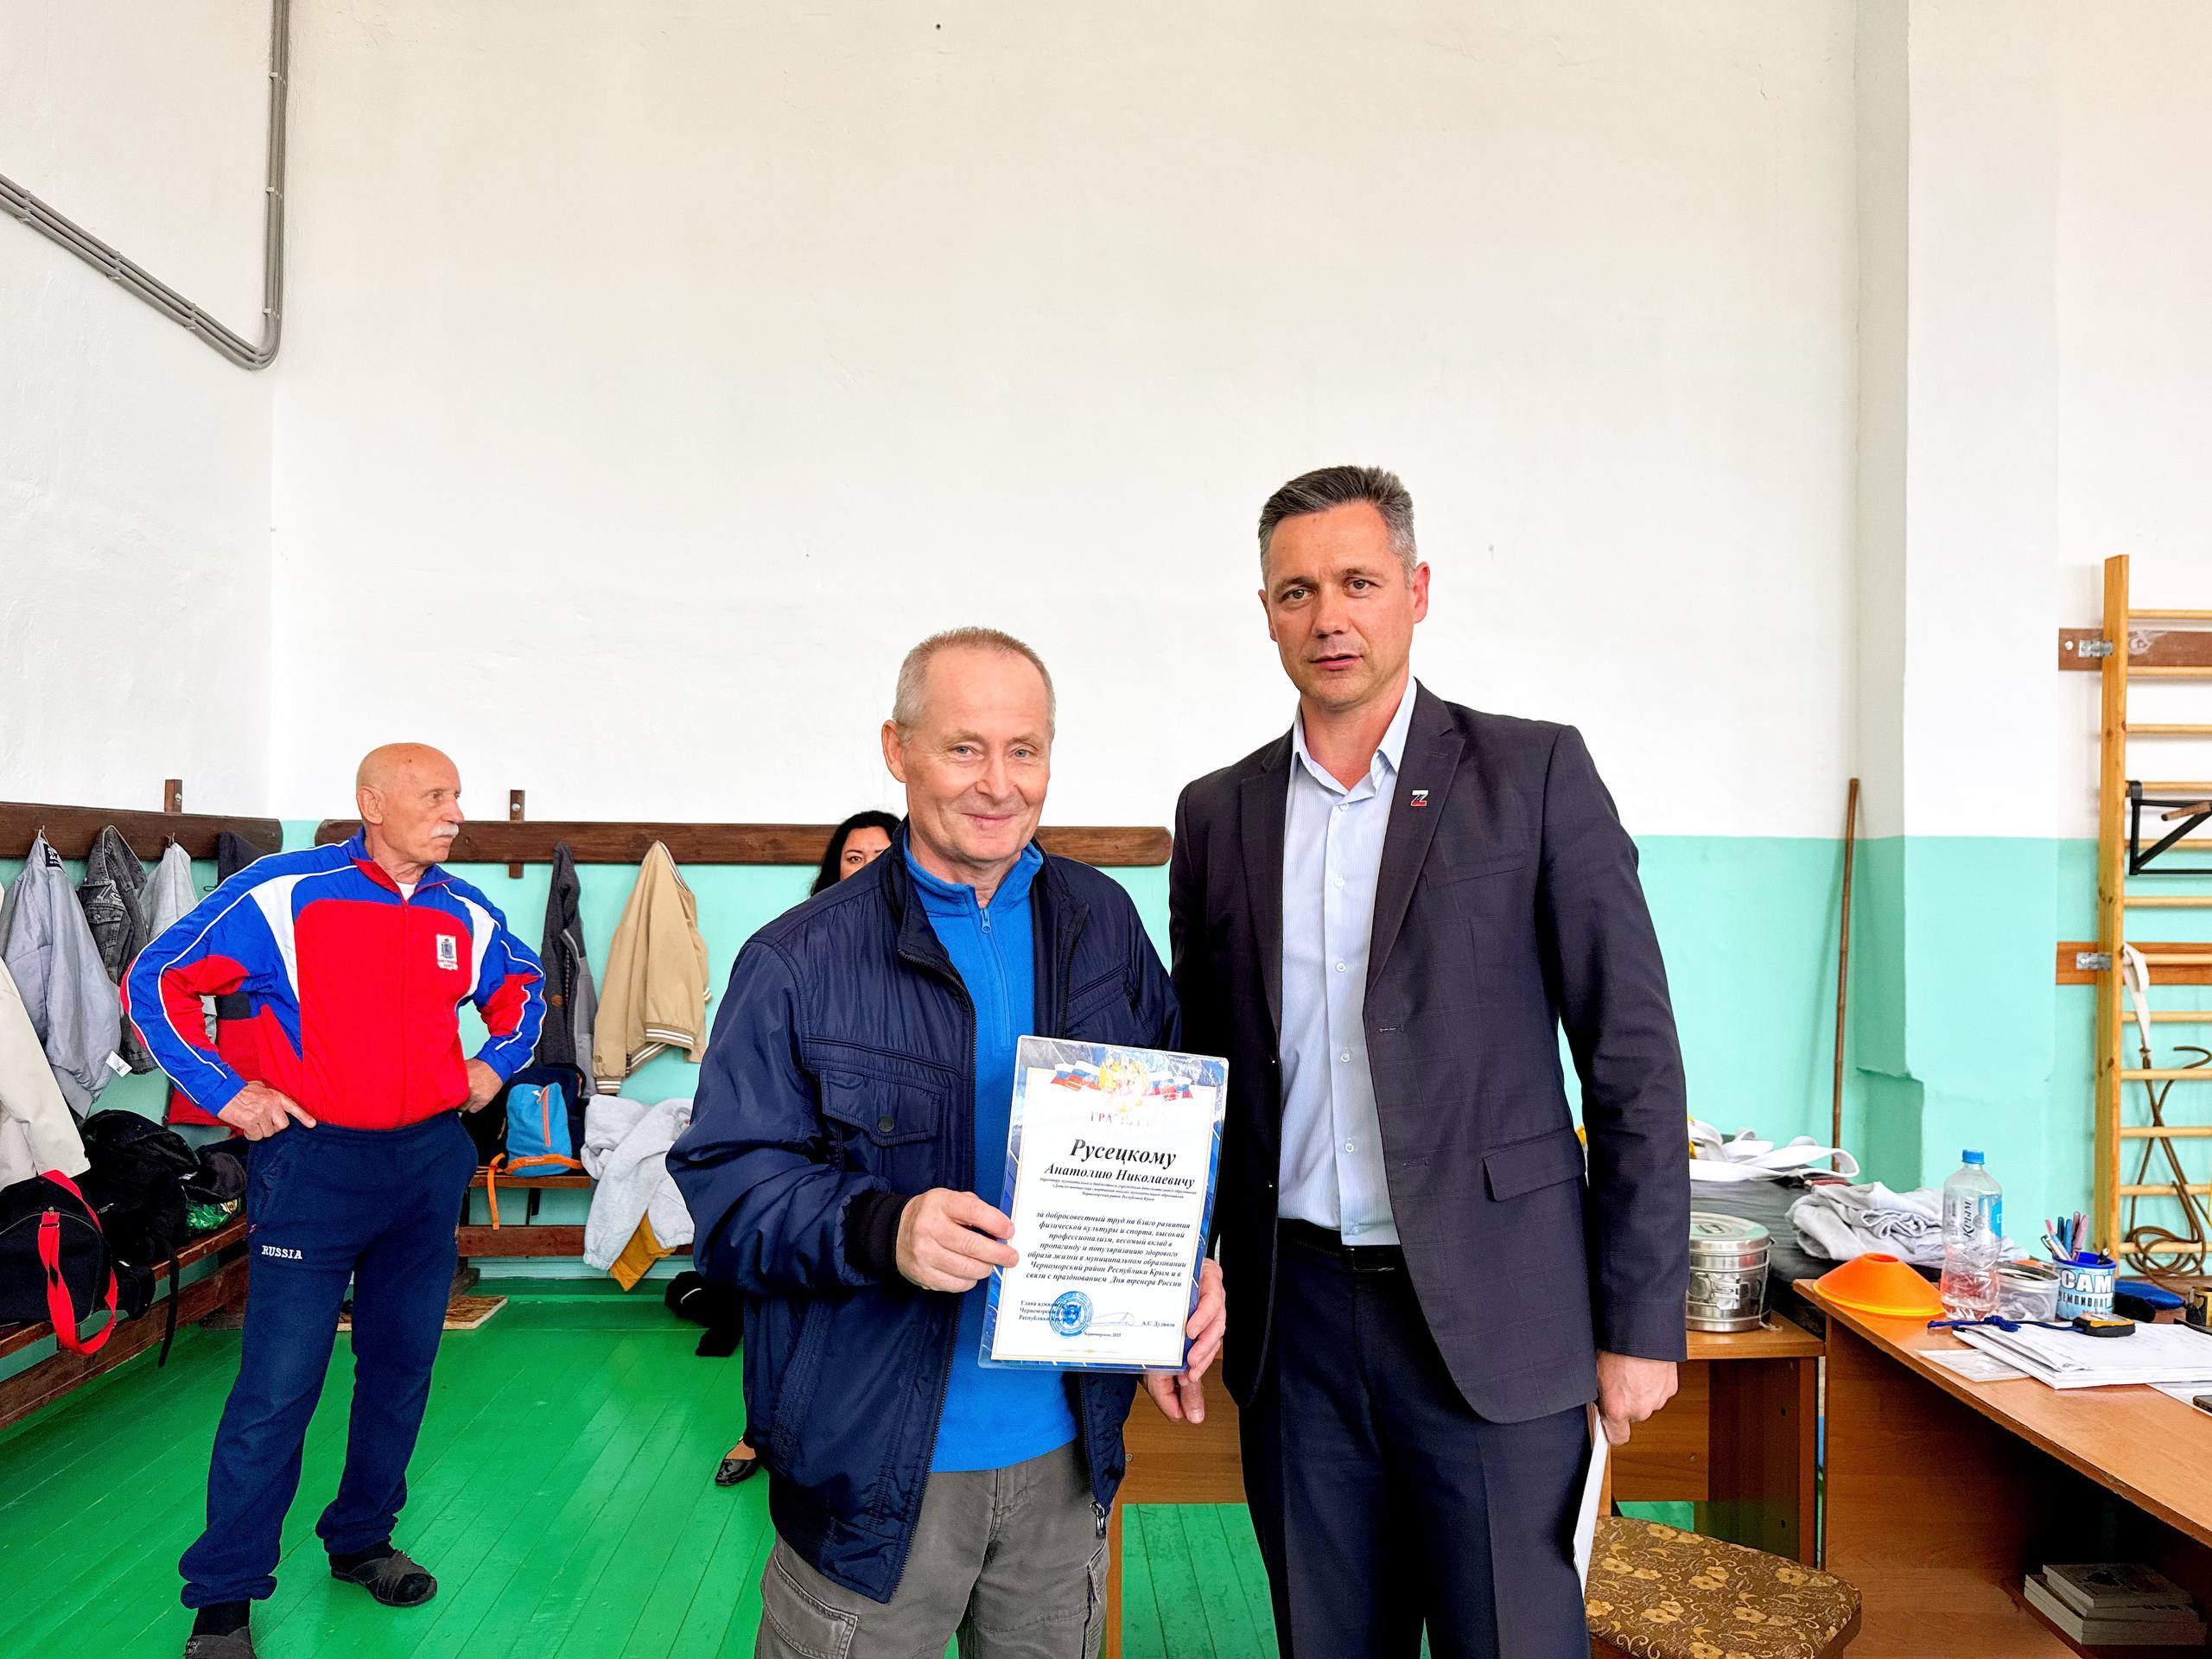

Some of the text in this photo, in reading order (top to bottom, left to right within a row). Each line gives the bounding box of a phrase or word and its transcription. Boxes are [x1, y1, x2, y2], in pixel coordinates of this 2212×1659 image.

[1410, 790, 1429, 807] Z
[1069, 1138, 1177, 1170] Русецкому
[1044, 1163, 1113, 1179] Анатолию
[1116, 1169, 1195, 1189] Николаевичу
[1046, 1211, 1106, 1223] добросовестный
[1039, 1221, 1082, 1230] физической
[1048, 1233, 1114, 1243] профессионализм,
[261, 1245, 302, 1260] RUSSIA
[1039, 1243, 1081, 1252] пропаганду
[1089, 1246, 1143, 1255] популяризацию
[1031, 1261, 1083, 1271] Черноморский
[1107, 1266, 1147, 1275] Республики
[1149, 1268, 1169, 1277] Крым
[1143, 1259, 1186, 1268] образовании
[1052, 1274, 1107, 1282] празднованием
[2061, 1268, 2115, 1294] САМ
